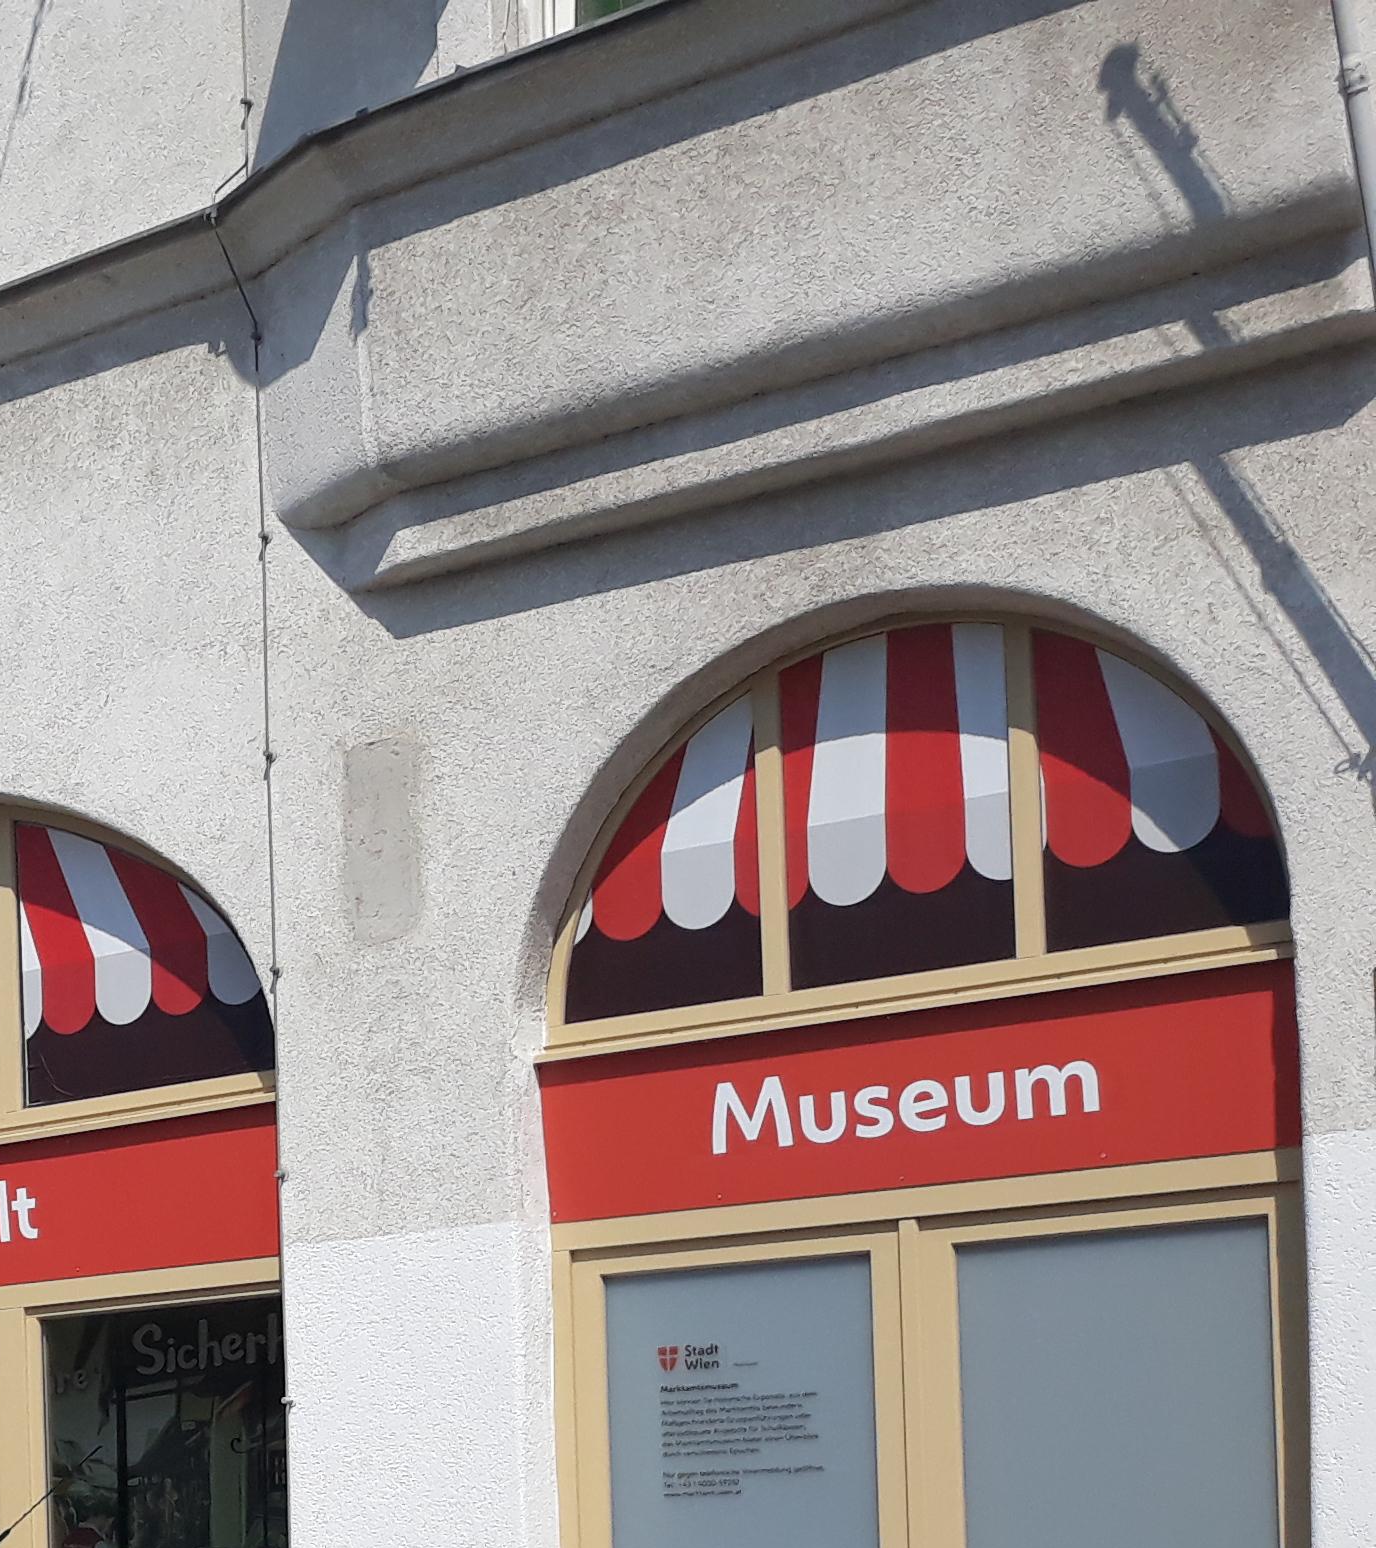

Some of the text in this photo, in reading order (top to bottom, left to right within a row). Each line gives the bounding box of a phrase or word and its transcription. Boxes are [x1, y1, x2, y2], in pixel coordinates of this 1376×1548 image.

[711, 1058, 1101, 1155] Museum
[684, 1342, 720, 1357] Stadt
[684, 1358, 720, 1371] Wien
